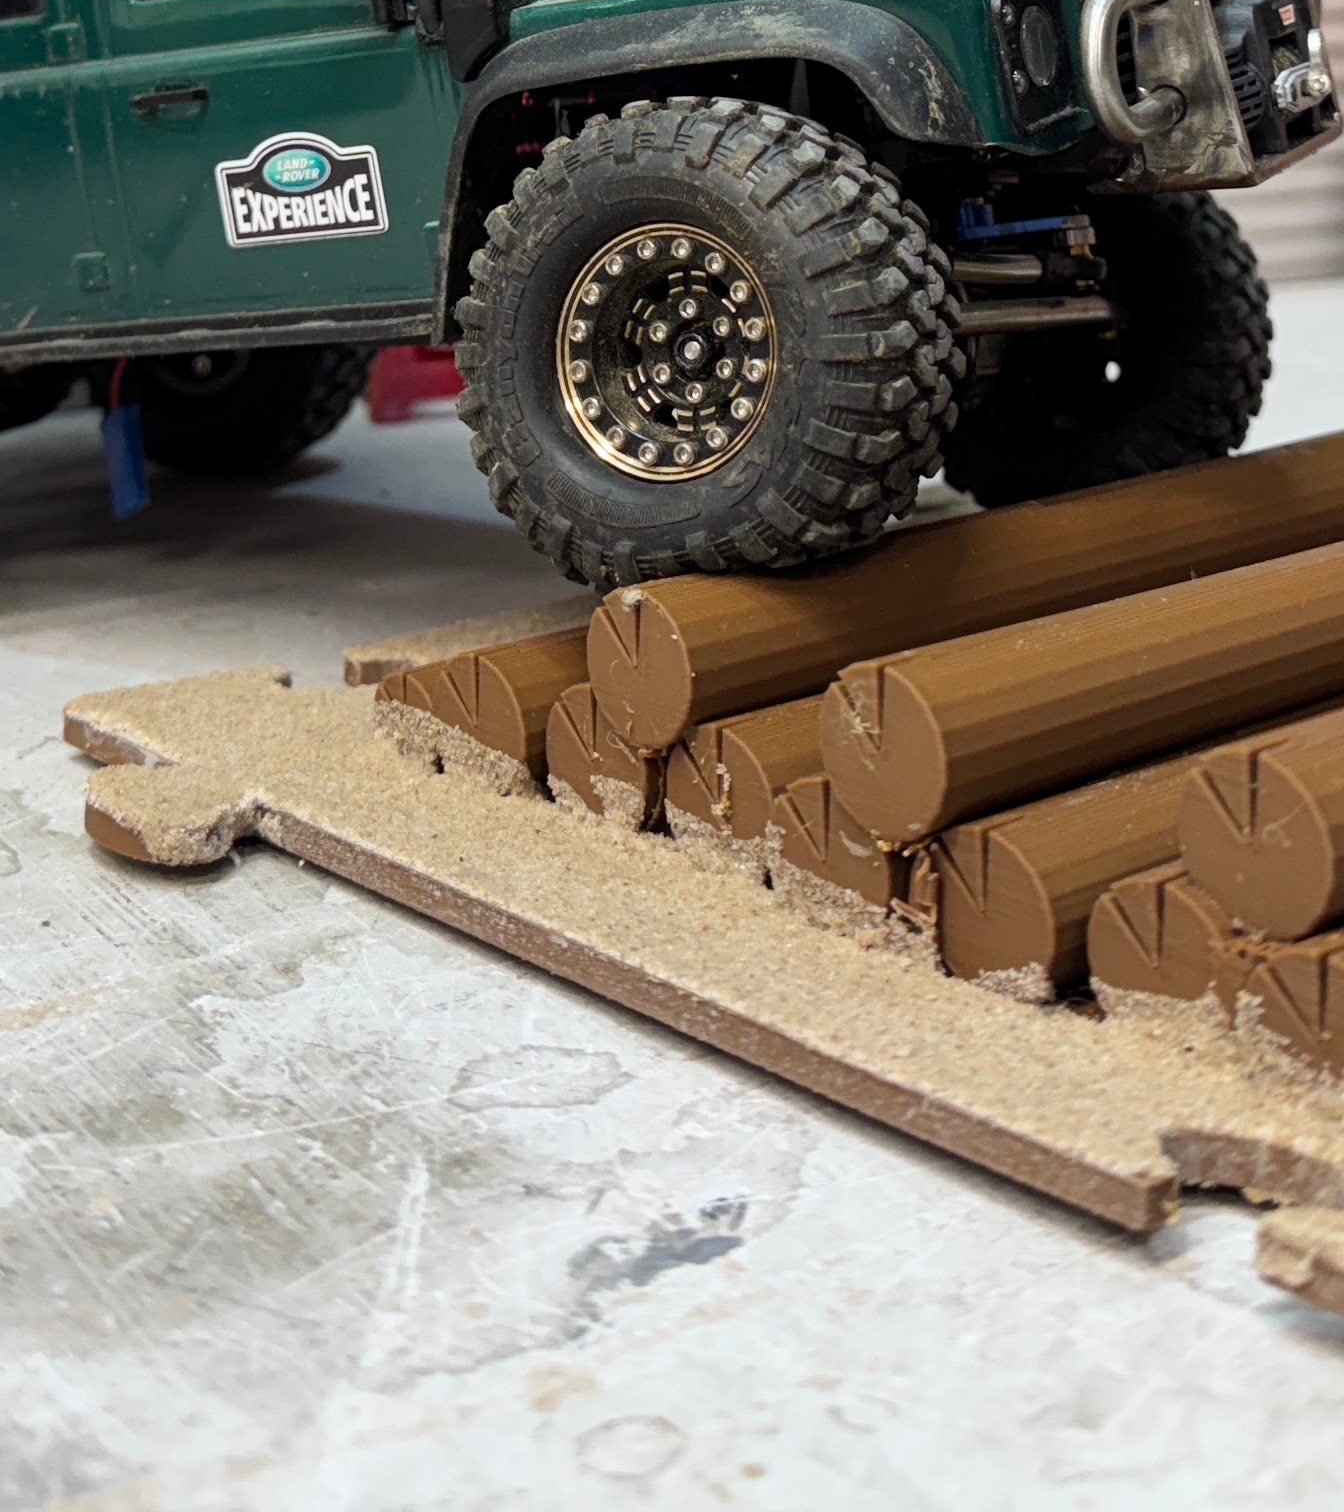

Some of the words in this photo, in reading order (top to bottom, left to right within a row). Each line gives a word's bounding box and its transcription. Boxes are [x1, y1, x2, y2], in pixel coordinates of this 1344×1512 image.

[277, 157, 307, 171] LAND
[282, 168, 321, 182] ROVER
[231, 174, 375, 234] EXPERIENCE
